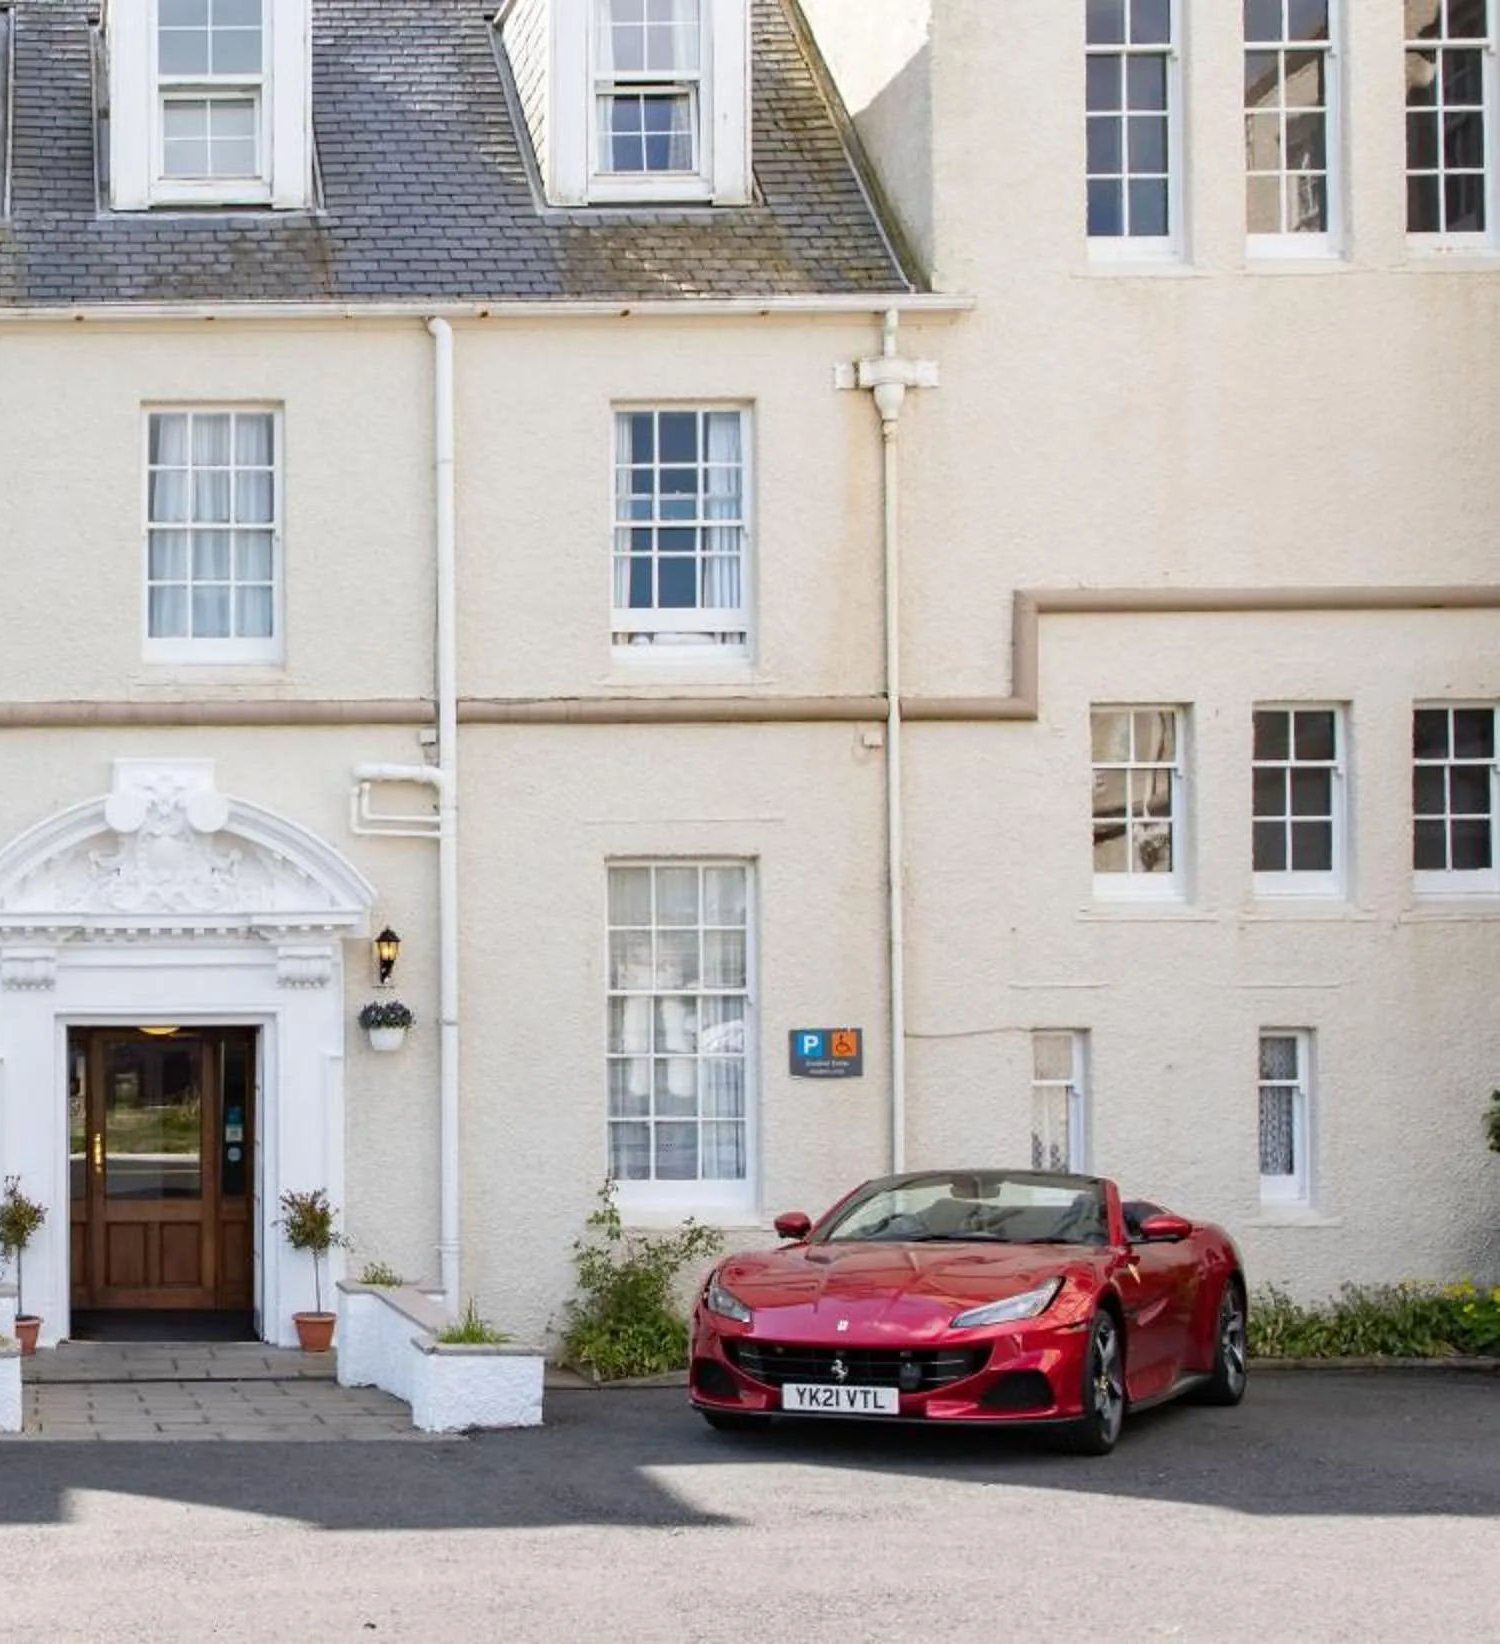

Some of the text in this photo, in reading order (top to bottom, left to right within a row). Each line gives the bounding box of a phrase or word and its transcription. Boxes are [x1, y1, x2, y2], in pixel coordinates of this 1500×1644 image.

[803, 1035, 819, 1055] P
[795, 1386, 885, 1409] YK21 VTL
